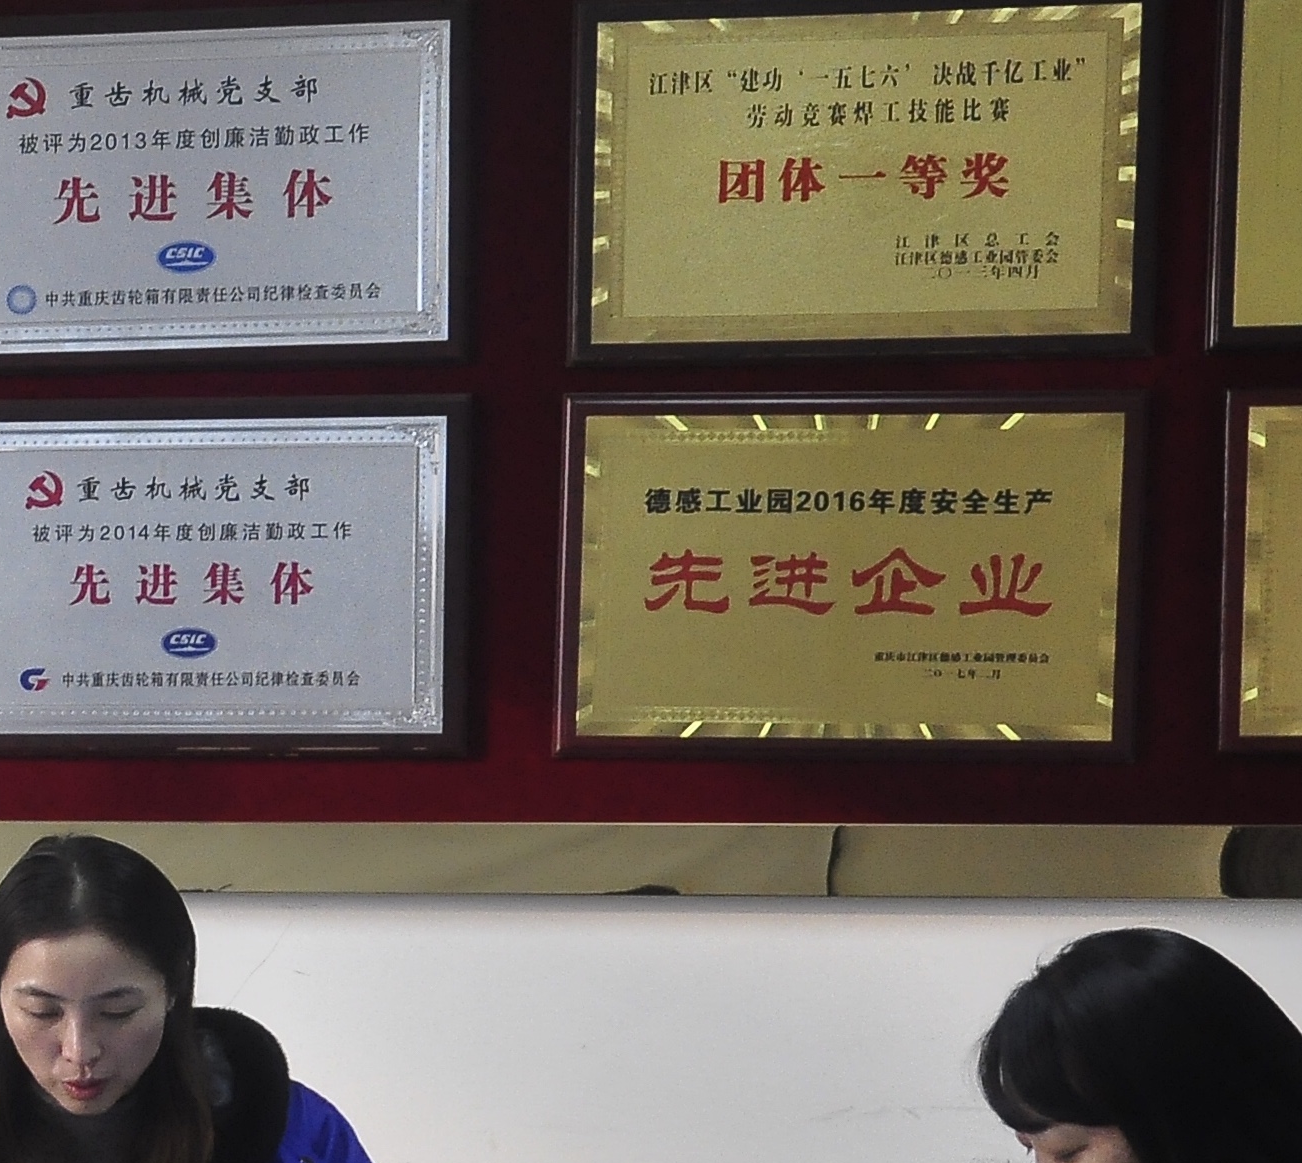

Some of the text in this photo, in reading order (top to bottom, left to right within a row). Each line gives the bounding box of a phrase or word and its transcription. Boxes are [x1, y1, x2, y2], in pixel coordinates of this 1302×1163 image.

[69, 75, 319, 110] 重齿机械党支部
[747, 98, 1011, 128] 劳动竞赛焊工技能比赛
[19, 123, 369, 154] 被评为2013年度创廉洁勤政工作
[718, 153, 1010, 203] 团体一等奖
[54, 169, 333, 224] 先进集体
[166, 246, 205, 260] CSIC
[45, 282, 381, 307] 中共重庆齿轮箱有限责任公司纪律检查委员会
[78, 474, 311, 502] 重齿机械党支部
[645, 487, 1052, 516] 德感工业园2016年度安全生产
[32, 522, 352, 543] 被评为2014年度创廉洁勤政工作
[70, 562, 314, 607] 先进集体
[644, 547, 1052, 617] 先进企业
[169, 633, 207, 646] CSIC
[62, 670, 361, 688] 中共重庆齿轮箱有限责任公司纪律检查委员会
